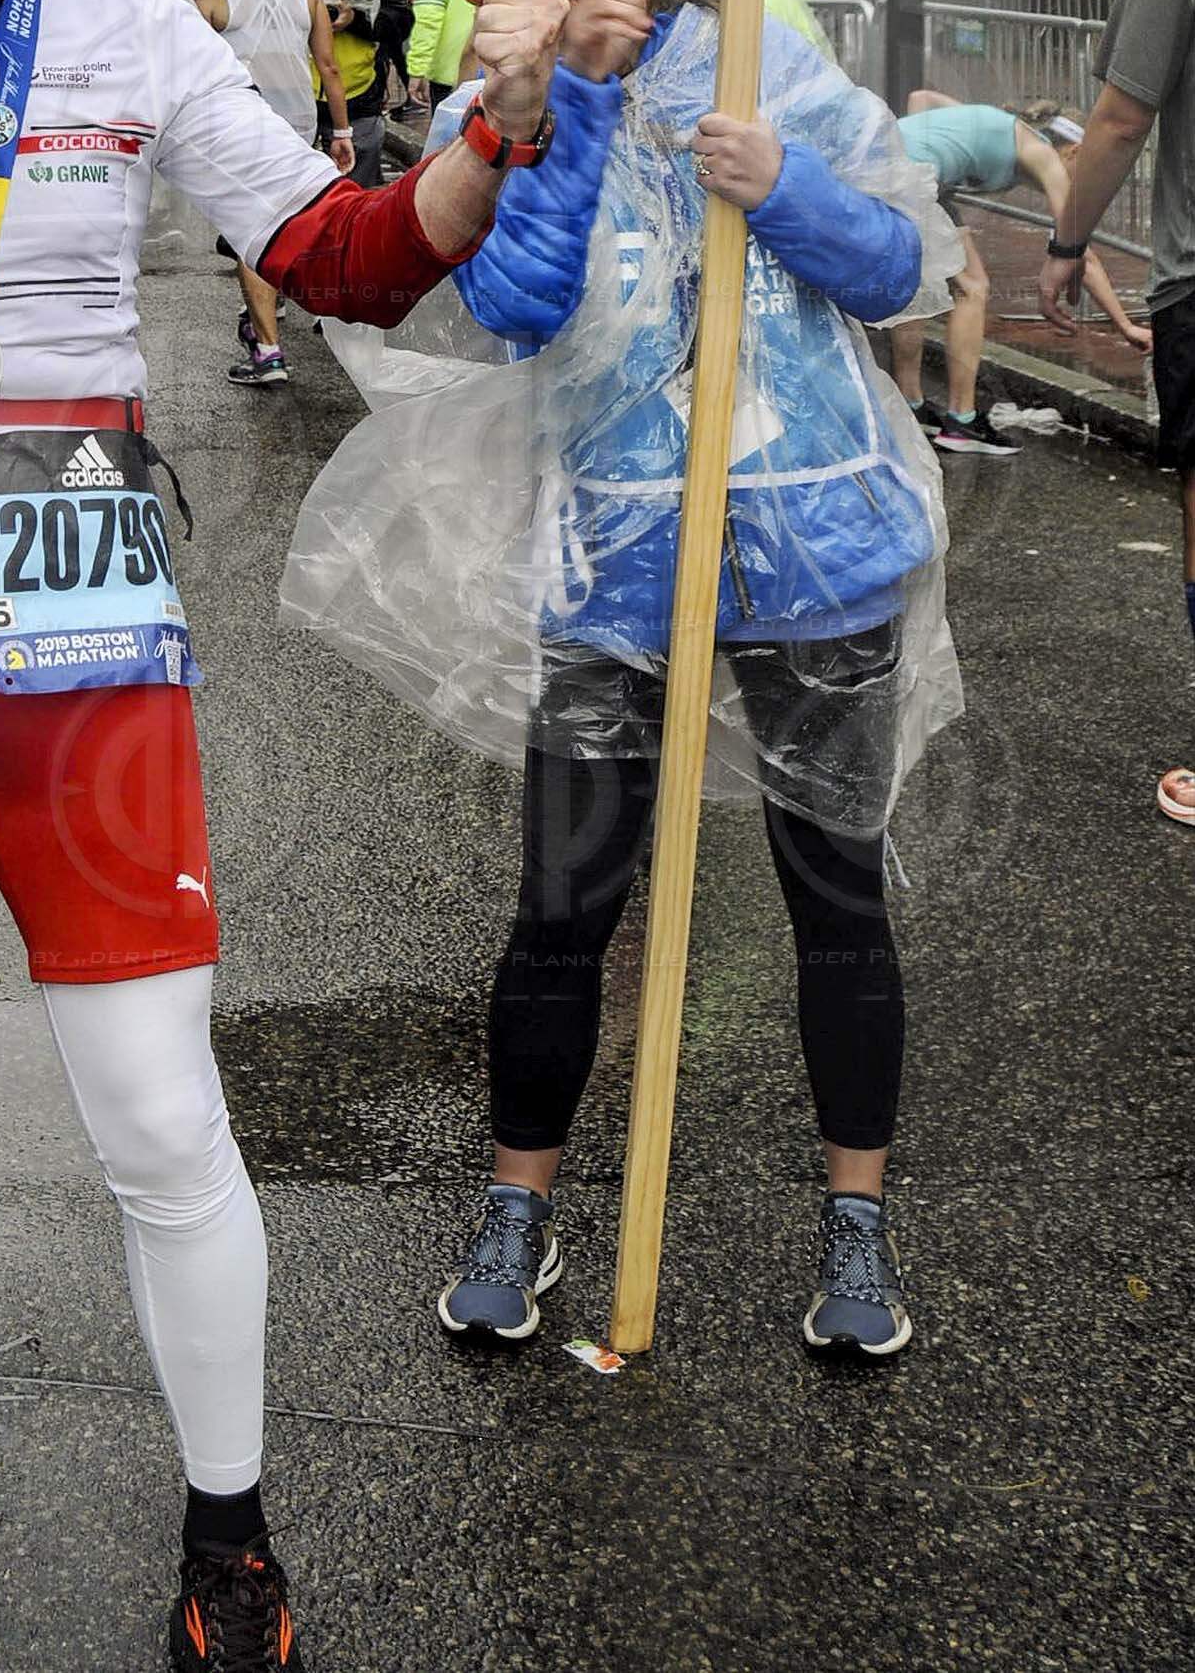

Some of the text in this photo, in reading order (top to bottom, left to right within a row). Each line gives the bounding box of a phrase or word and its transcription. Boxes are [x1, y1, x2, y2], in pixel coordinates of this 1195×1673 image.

[58, 165, 109, 183] GRAWE
[62, 468, 124, 488] adidas
[34, 637, 69, 653] 2019
[71, 631, 136, 648] BOSTON
